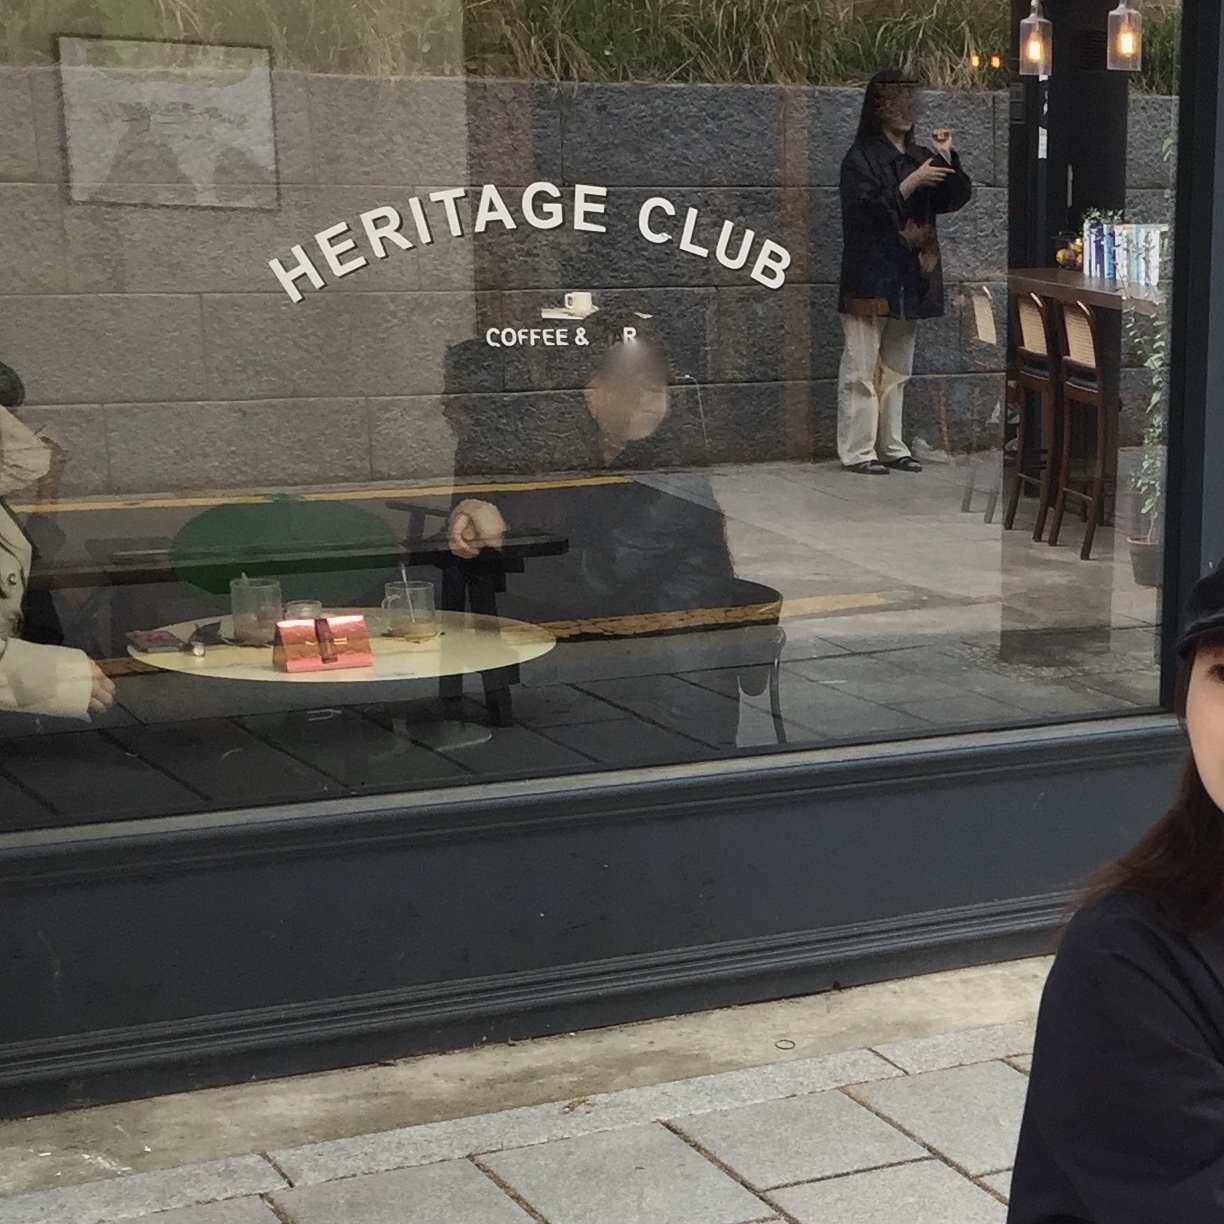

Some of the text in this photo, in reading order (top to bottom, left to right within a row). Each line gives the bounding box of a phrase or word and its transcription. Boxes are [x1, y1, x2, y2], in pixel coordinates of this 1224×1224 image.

[268, 181, 792, 303] HERITAGE CLUB
[485, 327, 569, 348] COFFEE
[574, 326, 590, 346] &
